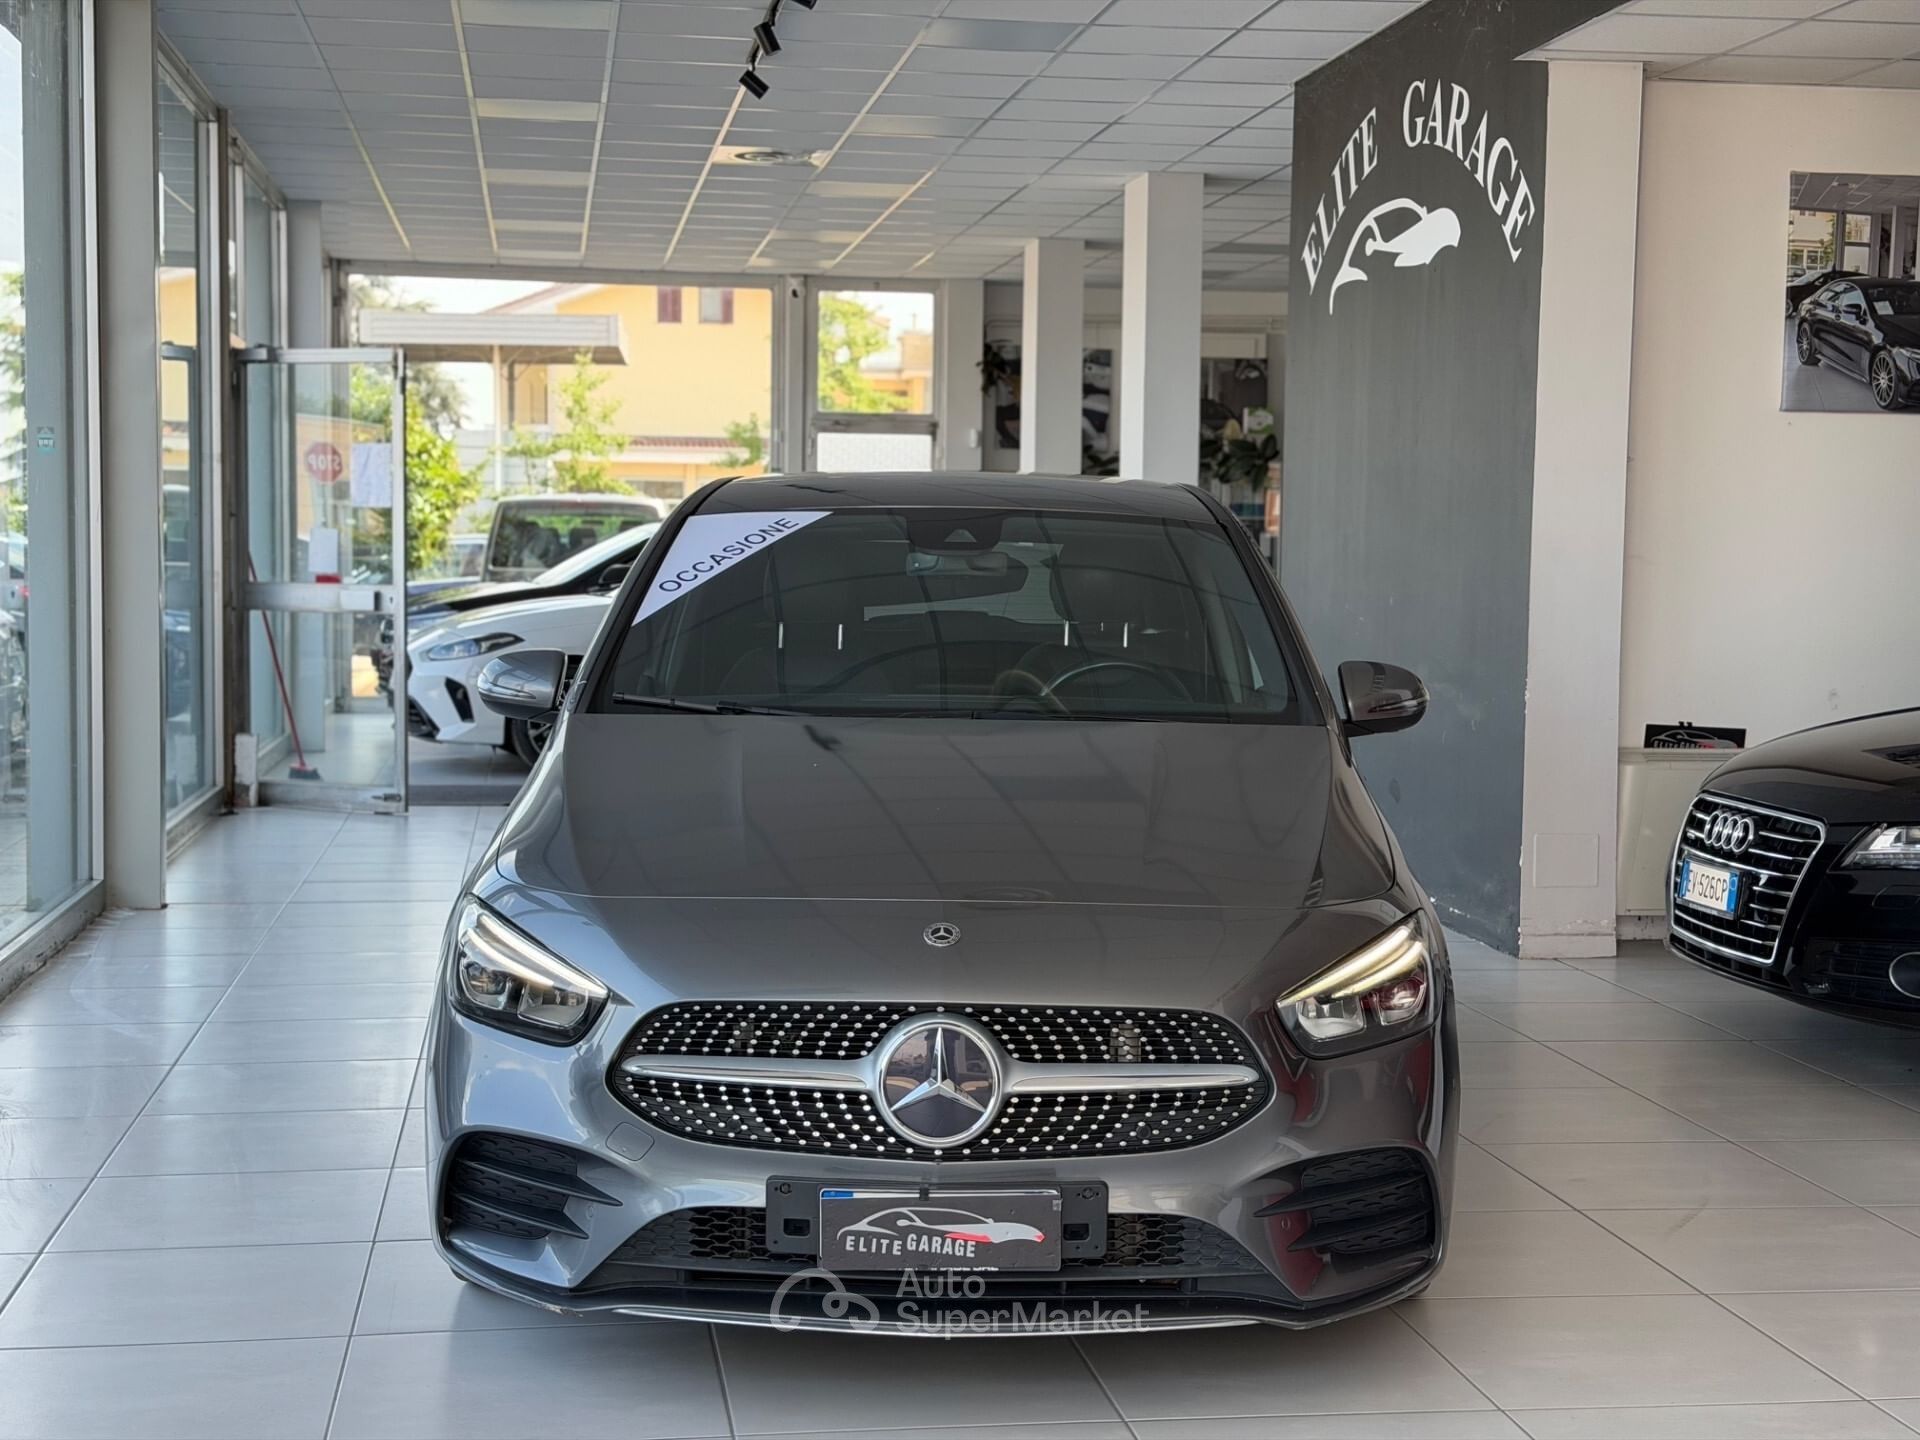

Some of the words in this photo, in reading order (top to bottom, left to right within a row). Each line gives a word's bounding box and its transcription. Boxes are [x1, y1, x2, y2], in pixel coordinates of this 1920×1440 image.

[1301, 107, 1379, 296] ELITE
[1402, 78, 1536, 263] GARAGE
[658, 517, 800, 594] OCCASIONE
[845, 1235, 903, 1256] ELITE
[906, 1233, 977, 1258] GARAGE
